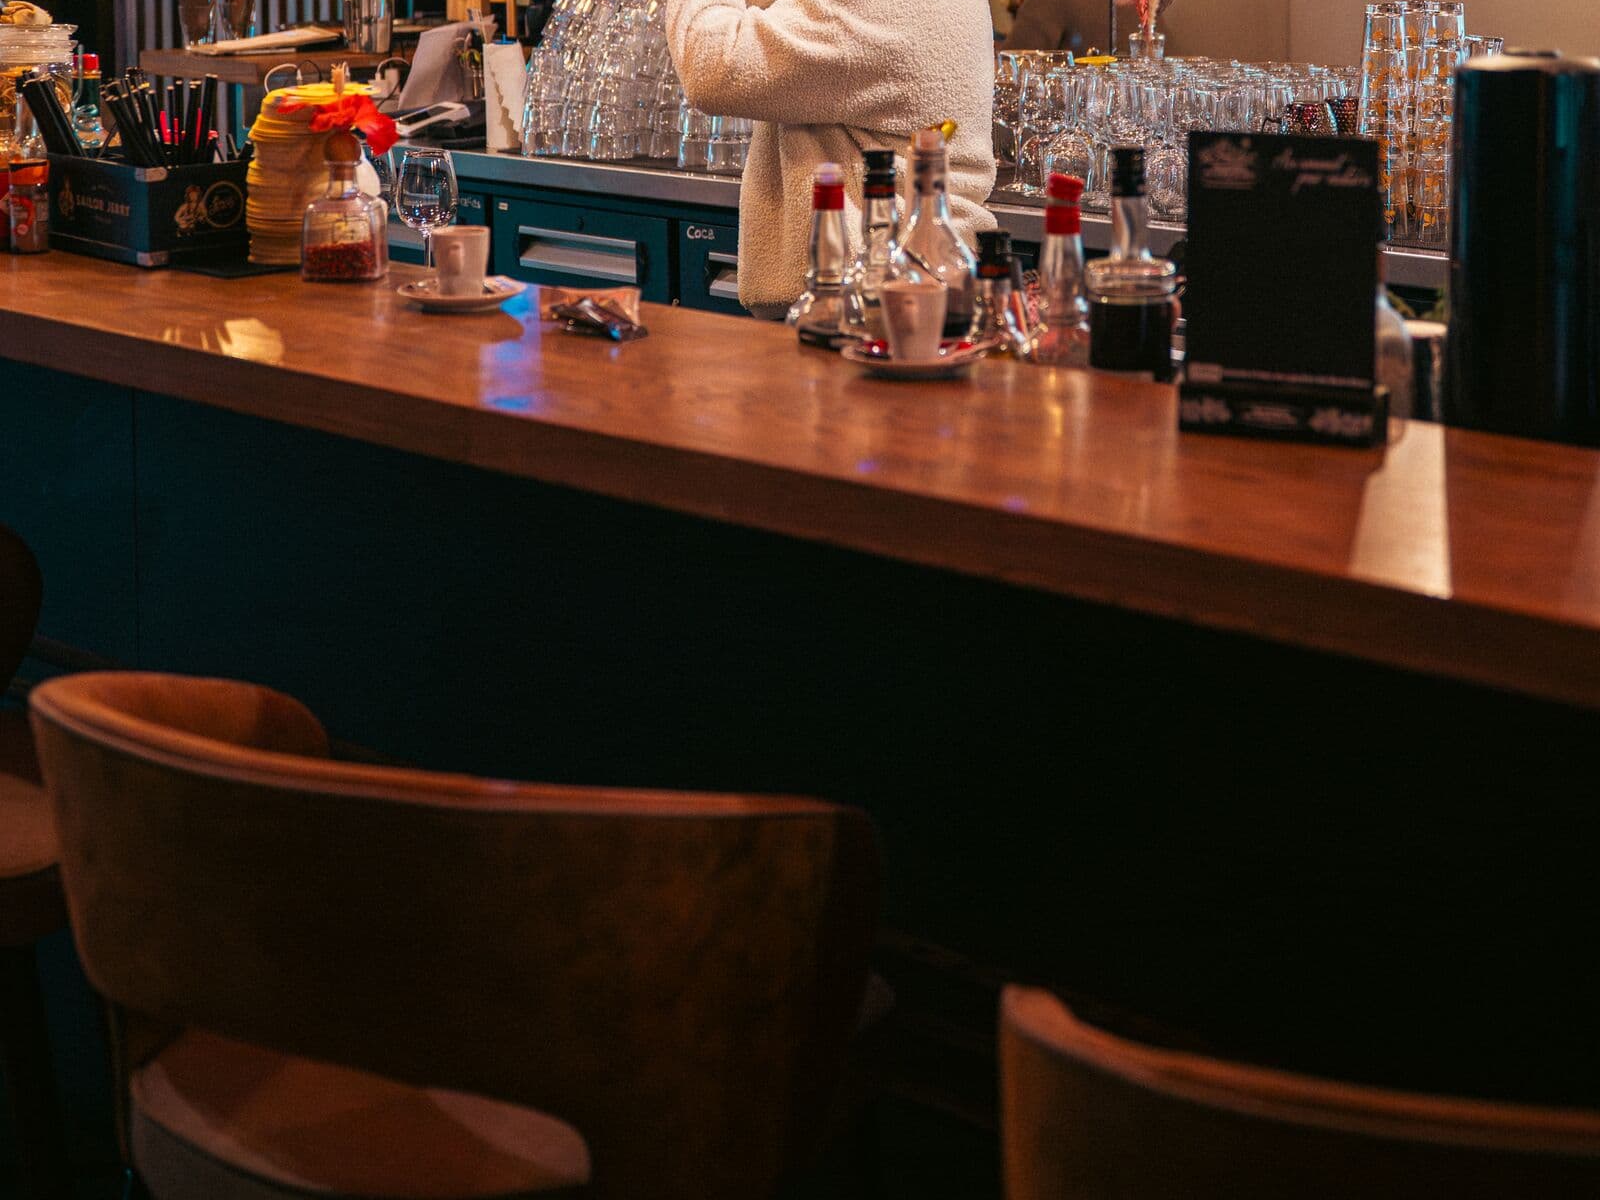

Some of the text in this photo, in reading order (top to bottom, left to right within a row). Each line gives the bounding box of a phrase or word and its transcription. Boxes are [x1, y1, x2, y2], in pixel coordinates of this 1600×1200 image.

[76, 194, 130, 216] SAILOR JERRY
[687, 225, 714, 240] Coca
